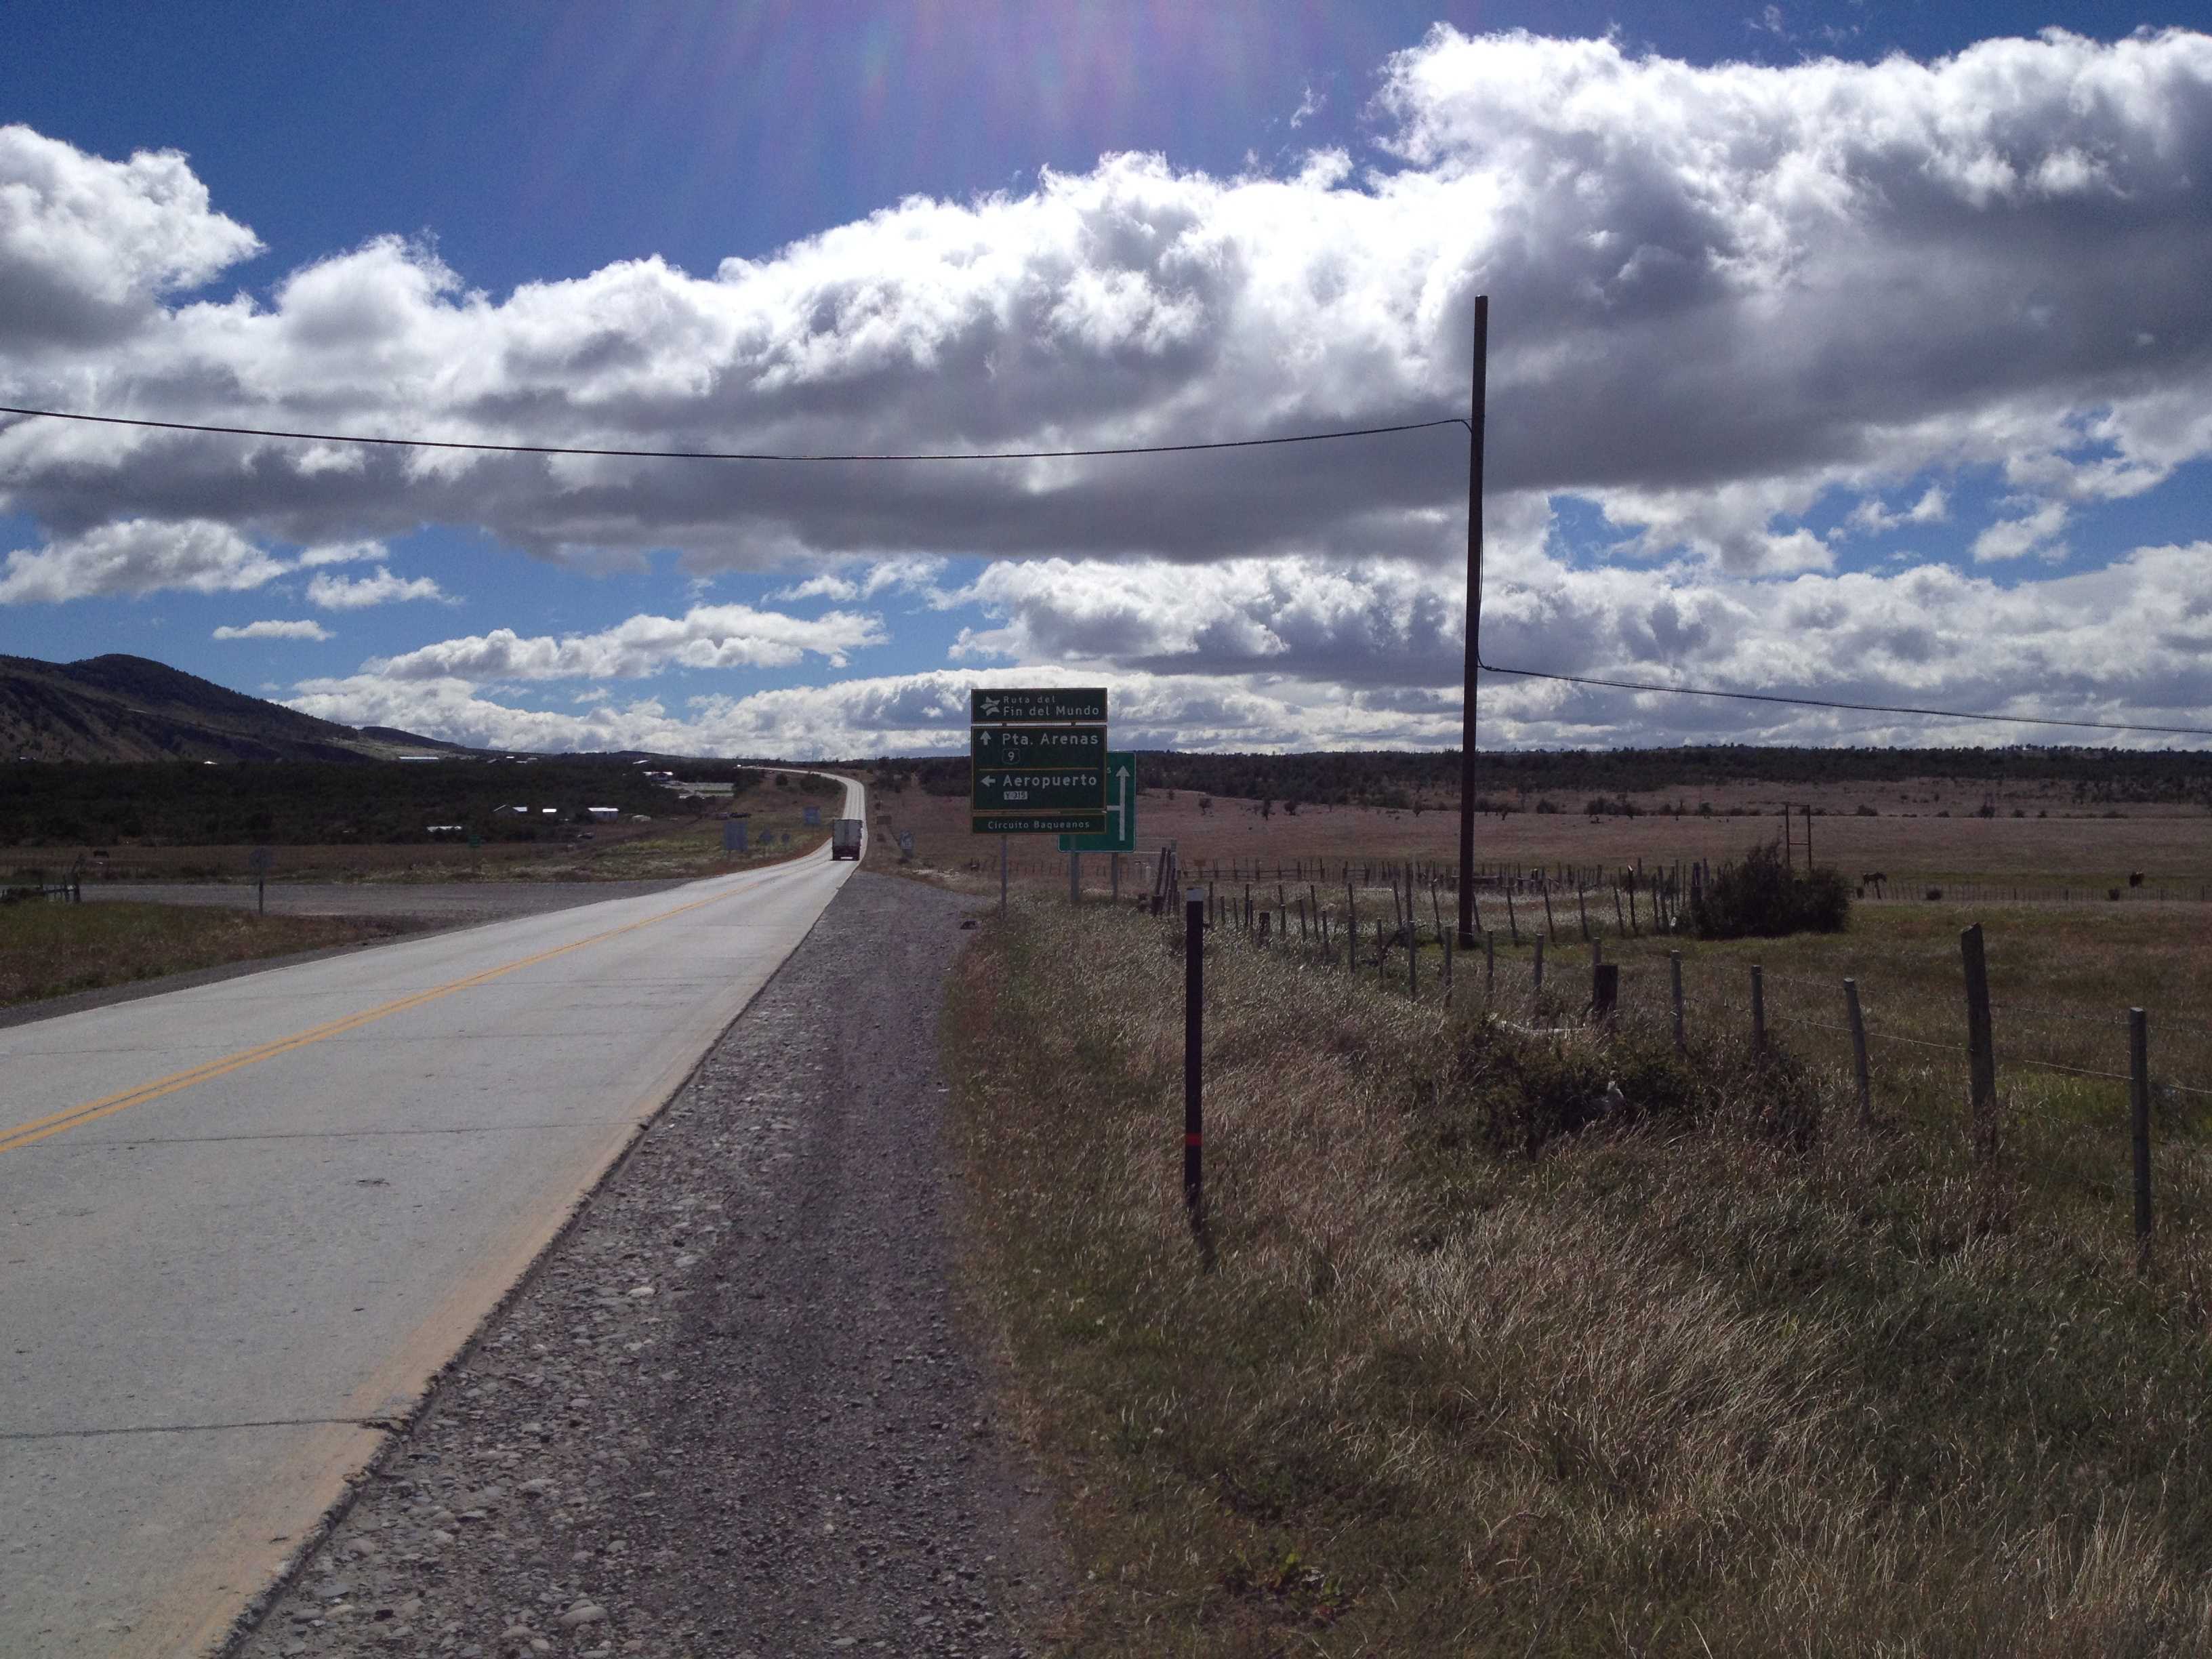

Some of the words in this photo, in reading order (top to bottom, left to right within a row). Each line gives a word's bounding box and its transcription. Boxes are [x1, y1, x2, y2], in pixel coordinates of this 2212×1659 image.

[1003, 695, 1030, 703] Ruta
[1037, 695, 1055, 703] del
[1003, 706, 1023, 716] Fin
[1029, 705, 1050, 716] del
[1056, 705, 1099, 716] Mundo
[1002, 733, 1033, 745] Pta.
[1040, 733, 1099, 745] Arenas
[1008, 752, 1015, 761] 9
[1003, 775, 1097, 789] Aeropuerto
[987, 820, 1029, 829] Circuito
[1033, 819, 1090, 830] Baqueanos
